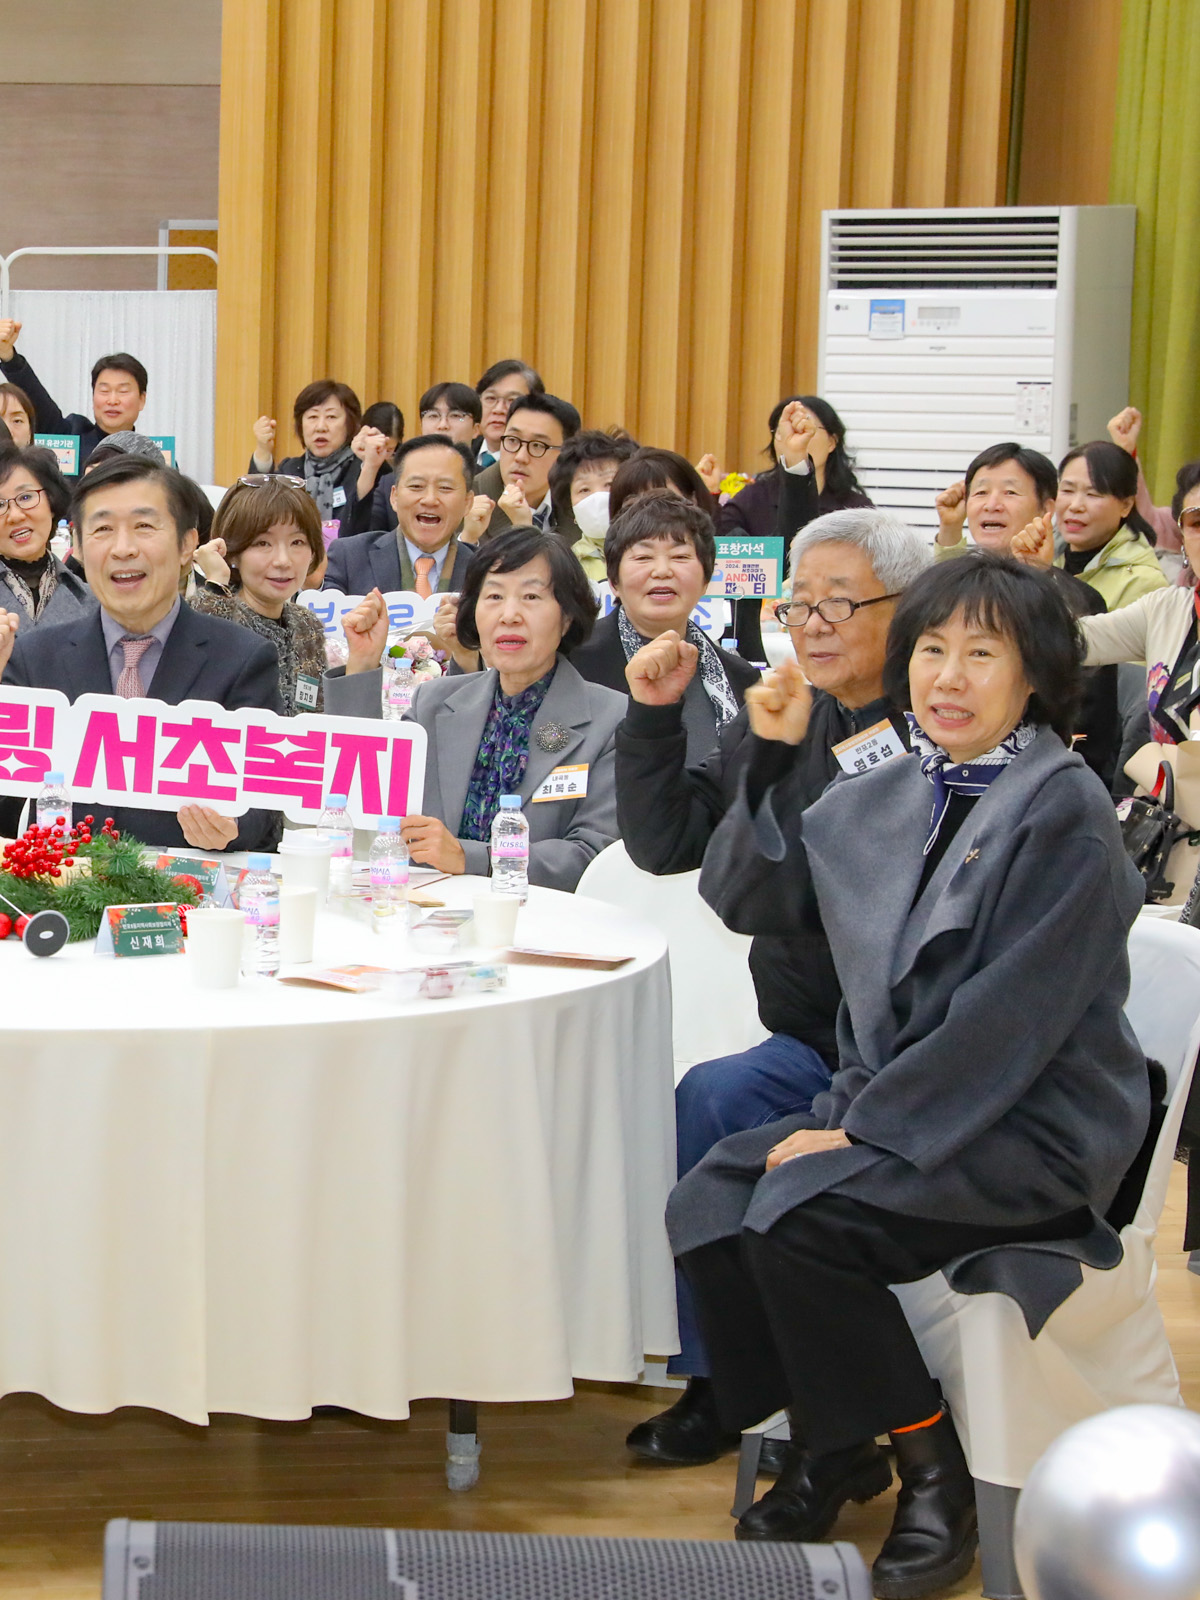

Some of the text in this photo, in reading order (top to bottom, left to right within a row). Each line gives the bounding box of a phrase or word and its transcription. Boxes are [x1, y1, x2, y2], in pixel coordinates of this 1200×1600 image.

[46, 439, 74, 448] 유관기관
[717, 542, 765, 556] 표창자석
[725, 573, 767, 582] ANDING
[72, 710, 413, 817] 서초복지
[129, 934, 166, 951] 신재희
